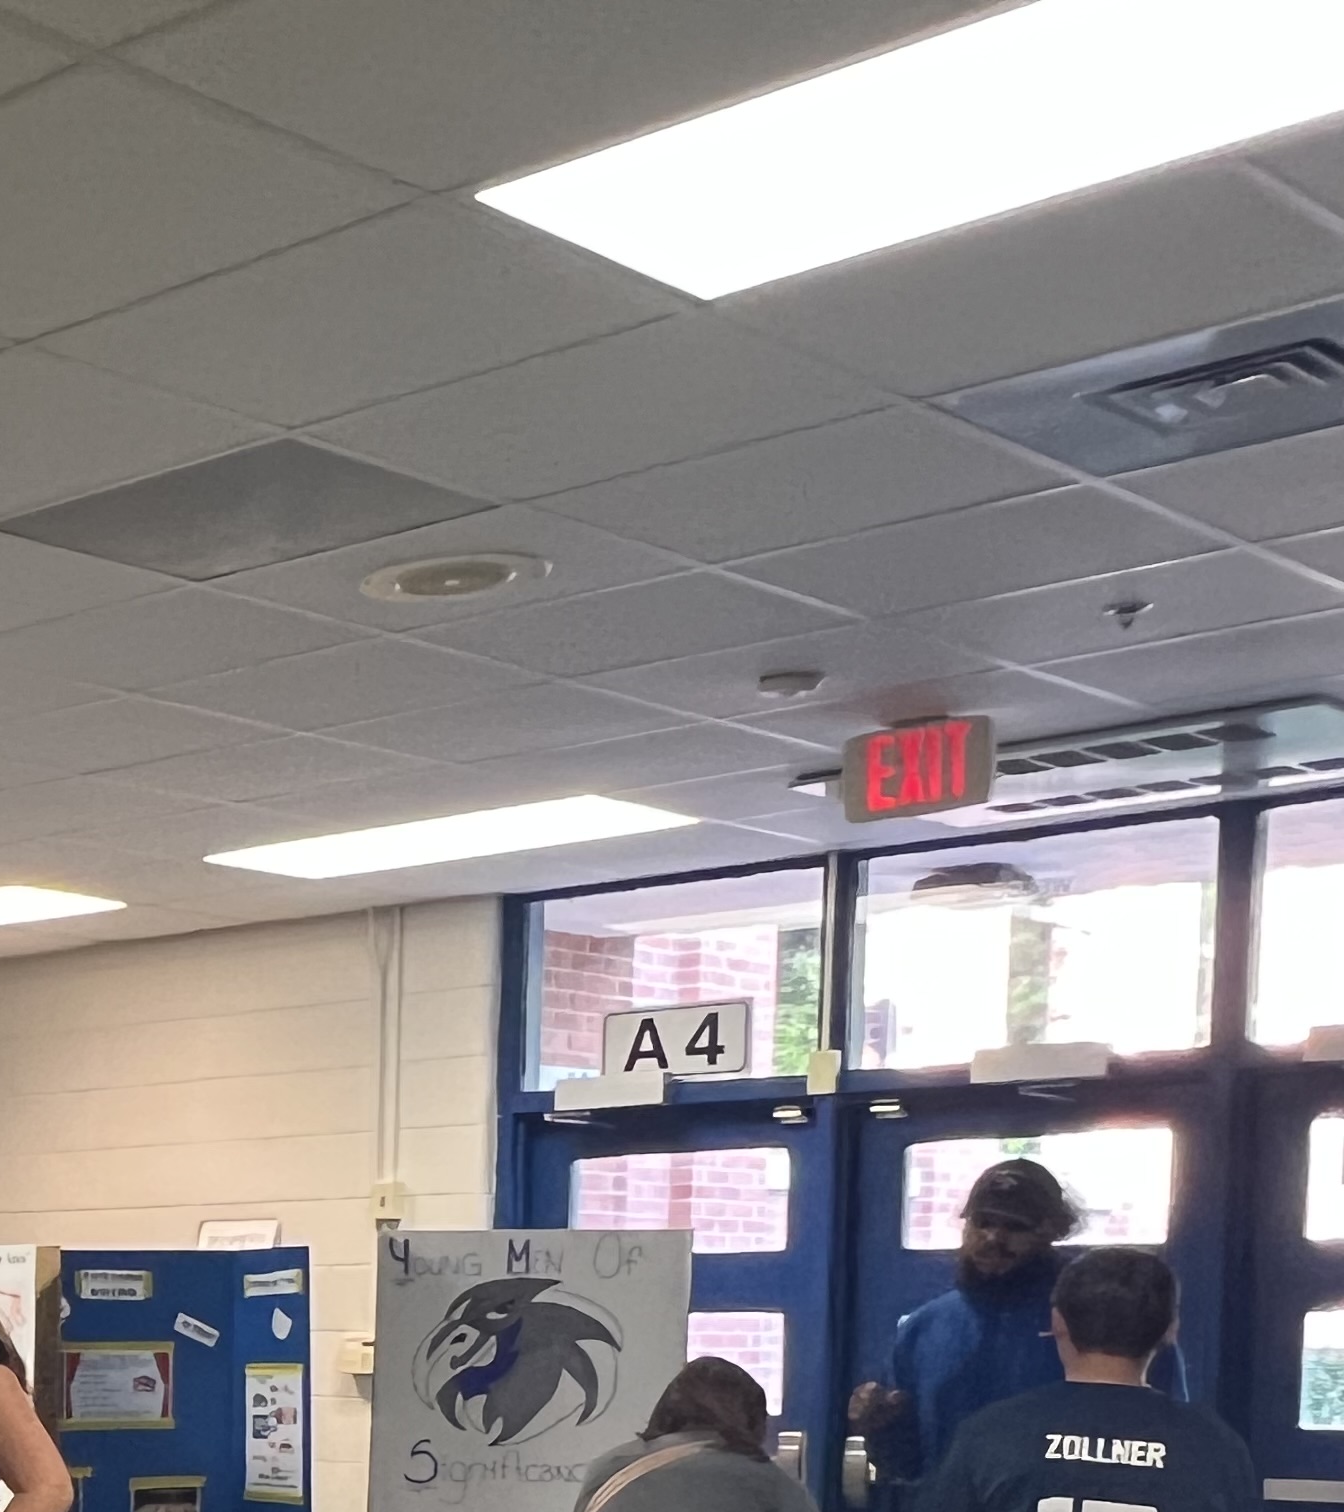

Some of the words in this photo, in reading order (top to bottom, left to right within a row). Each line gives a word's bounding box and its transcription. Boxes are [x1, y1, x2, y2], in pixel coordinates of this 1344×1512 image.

[866, 720, 972, 814] EXIT
[623, 1017, 669, 1072] A
[685, 1012, 725, 1066] 4
[403, 1438, 589, 1506] Significanc
[1044, 1433, 1167, 1469] ZOLLNER
